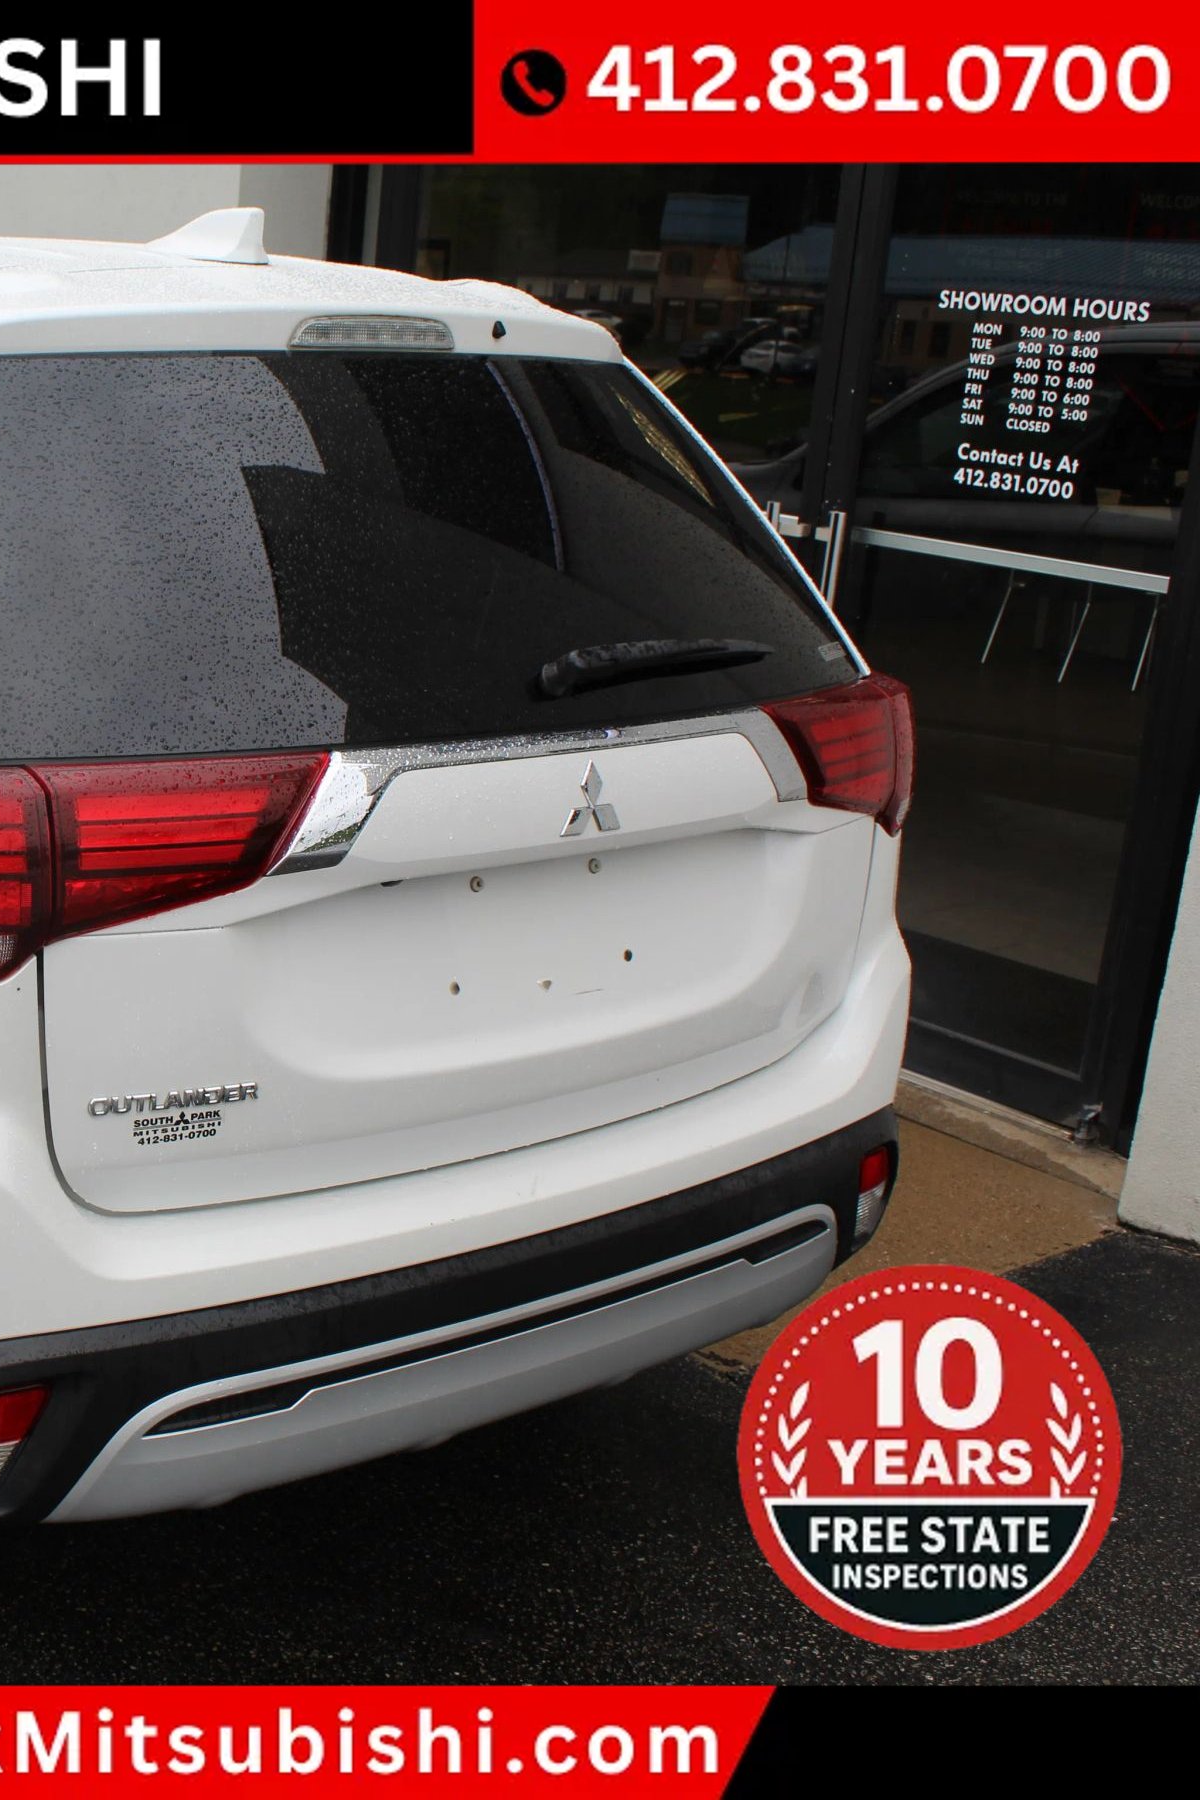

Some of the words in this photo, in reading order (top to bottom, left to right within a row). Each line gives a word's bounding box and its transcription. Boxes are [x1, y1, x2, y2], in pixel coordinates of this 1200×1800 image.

[938, 289, 1066, 317] SHOWROOM
[1072, 298, 1151, 322] HOURS
[973, 322, 1003, 336] MON
[1020, 326, 1046, 339] 9:00
[1051, 328, 1068, 340] TO
[1073, 330, 1101, 343] 8:00
[971, 338, 992, 350] TUE
[1018, 342, 1042, 354] 9:00
[1049, 344, 1064, 356] TO
[1071, 346, 1099, 359] 8:00
[969, 353, 995, 366] WED
[1016, 357, 1040, 370] 9:00
[1046, 359, 1063, 371] TO
[1068, 361, 1095, 374] 8:00
[967, 368, 990, 381] THU
[1013, 373, 1039, 386] 9:00
[1044, 375, 1061, 387] TO
[1066, 377, 1093, 390] 8:00
[964, 383, 982, 395] FRI
[1011, 388, 1036, 401] 9:00
[1041, 391, 1057, 402] TO
[1063, 393, 1090, 406] 6:00
[962, 398, 983, 410] SAT
[1008, 403, 1033, 416] 9:00
[1038, 406, 1053, 418] TO
[1061, 409, 1088, 421] 5:00
[960, 413, 984, 426] SUN
[1006, 418, 1050, 433] CLOSED
[957, 443, 1024, 467] Contact
[1029, 452, 1051, 470] Us
[1056, 454, 1080, 474] At
[954, 468, 1074, 499] 412.831.0700
[88, 1081, 259, 1117] OUTLANDER
[133, 1121, 221, 1137] MITSUBISHI
[134, 1116, 174, 1128] SOUTH
[191, 1110, 221, 1121] PARK
[138, 1129, 216, 1145] 412-831-0700
